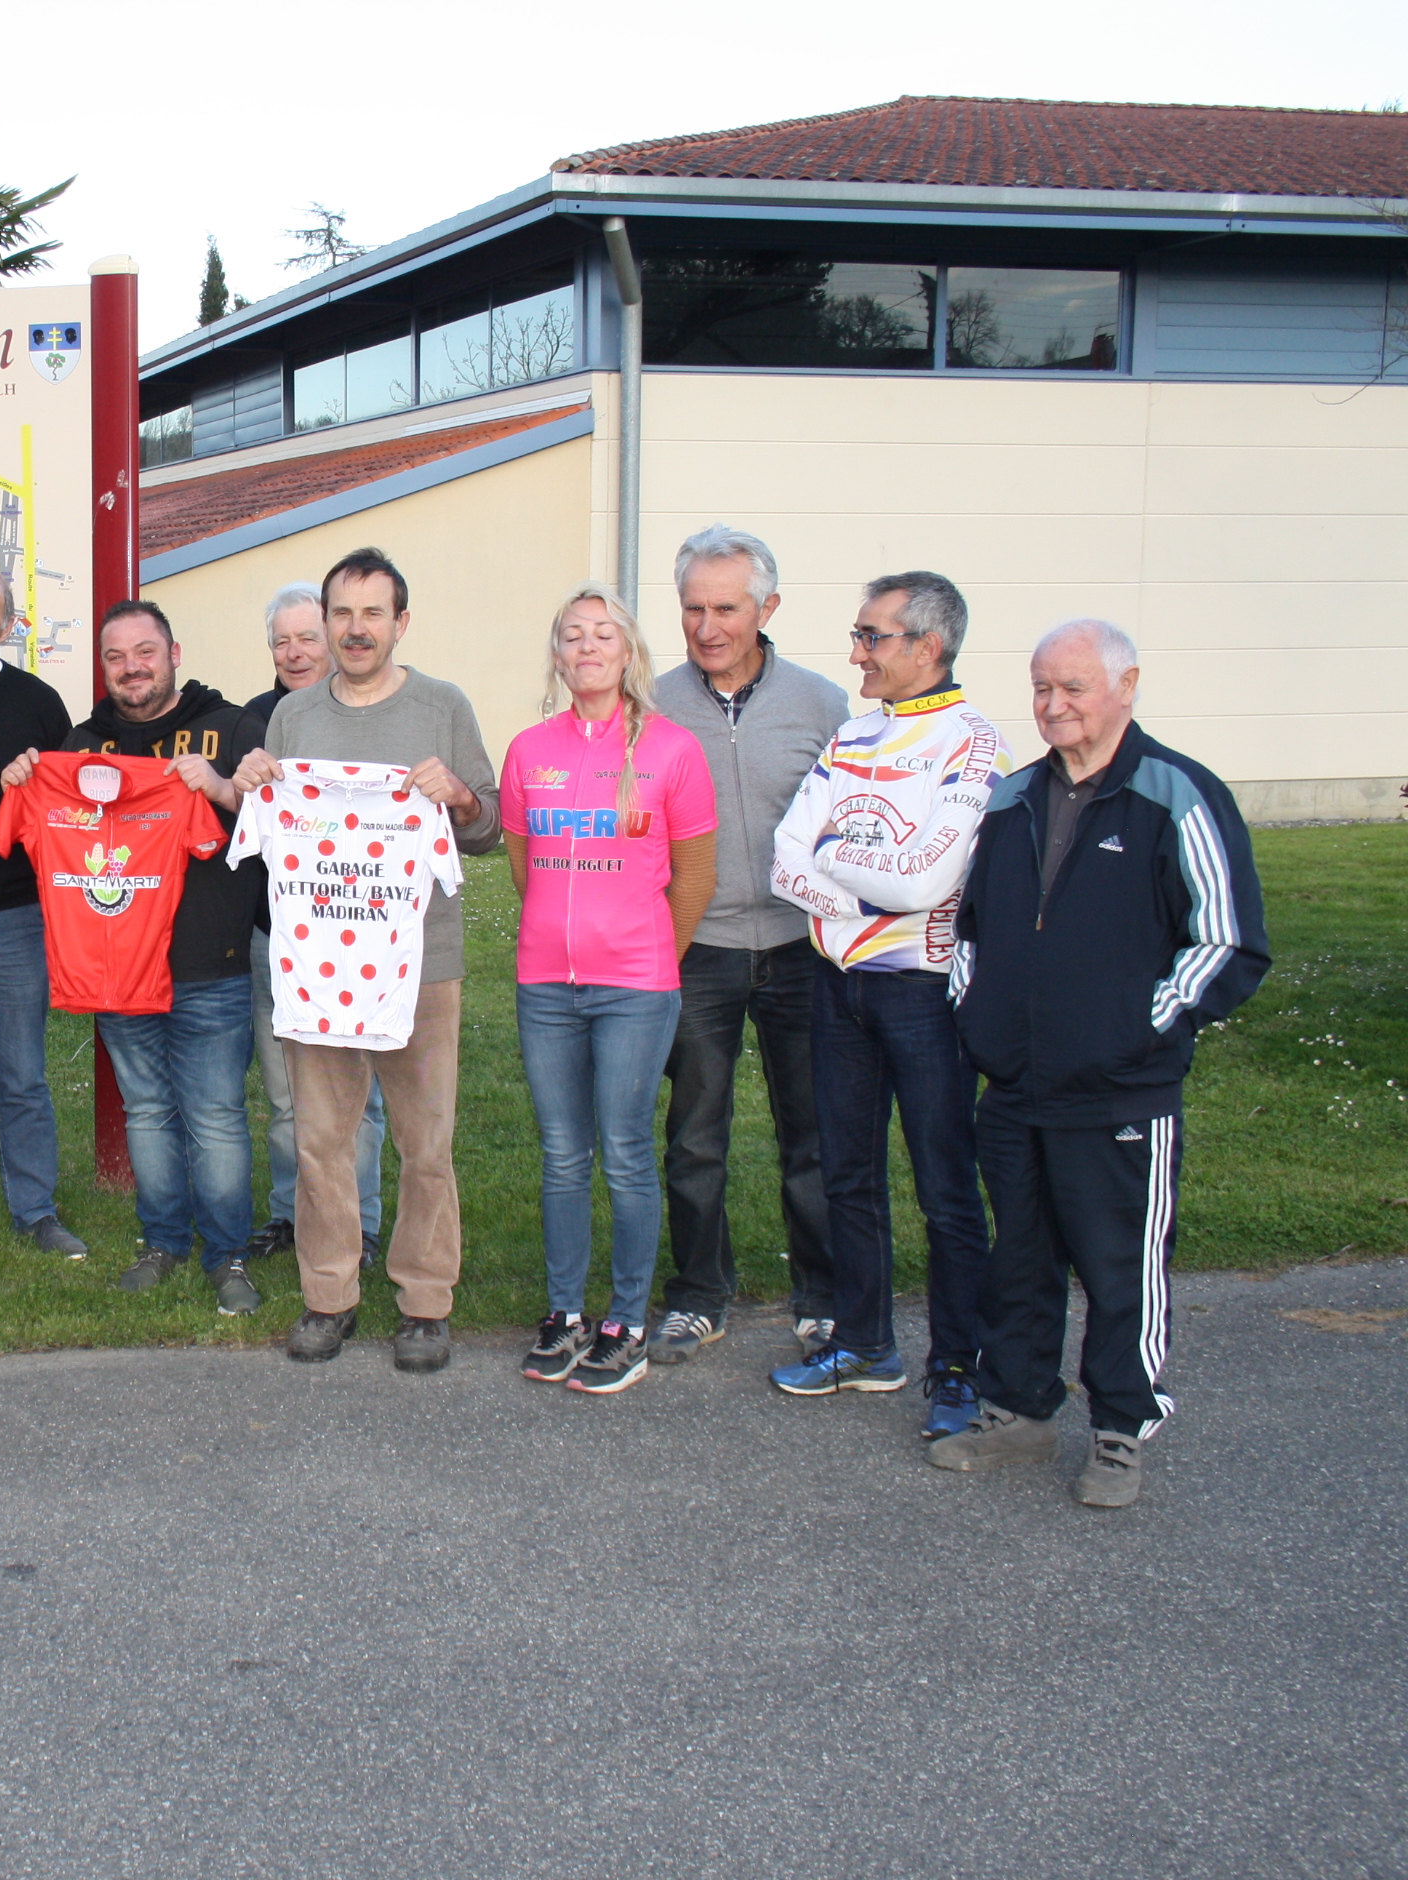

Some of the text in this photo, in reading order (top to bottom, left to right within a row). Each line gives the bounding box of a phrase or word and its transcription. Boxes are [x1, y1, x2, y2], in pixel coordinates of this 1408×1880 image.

[895, 756, 934, 773] C.C.M
[47, 806, 104, 826] ufolep
[839, 797, 891, 818] CHATEAU
[282, 815, 339, 839] ufolep
[360, 822, 375, 830] TOUR
[375, 823, 385, 831] DU
[1098, 842, 1123, 853] adidas
[316, 860, 385, 878] GARAGE
[532, 856, 625, 872] MAUBOURGUET
[878, 853, 894, 873] DE
[776, 869, 791, 890] DE
[311, 904, 389, 922] MADIRAN
[1114, 1133, 1144, 1142] adidas
